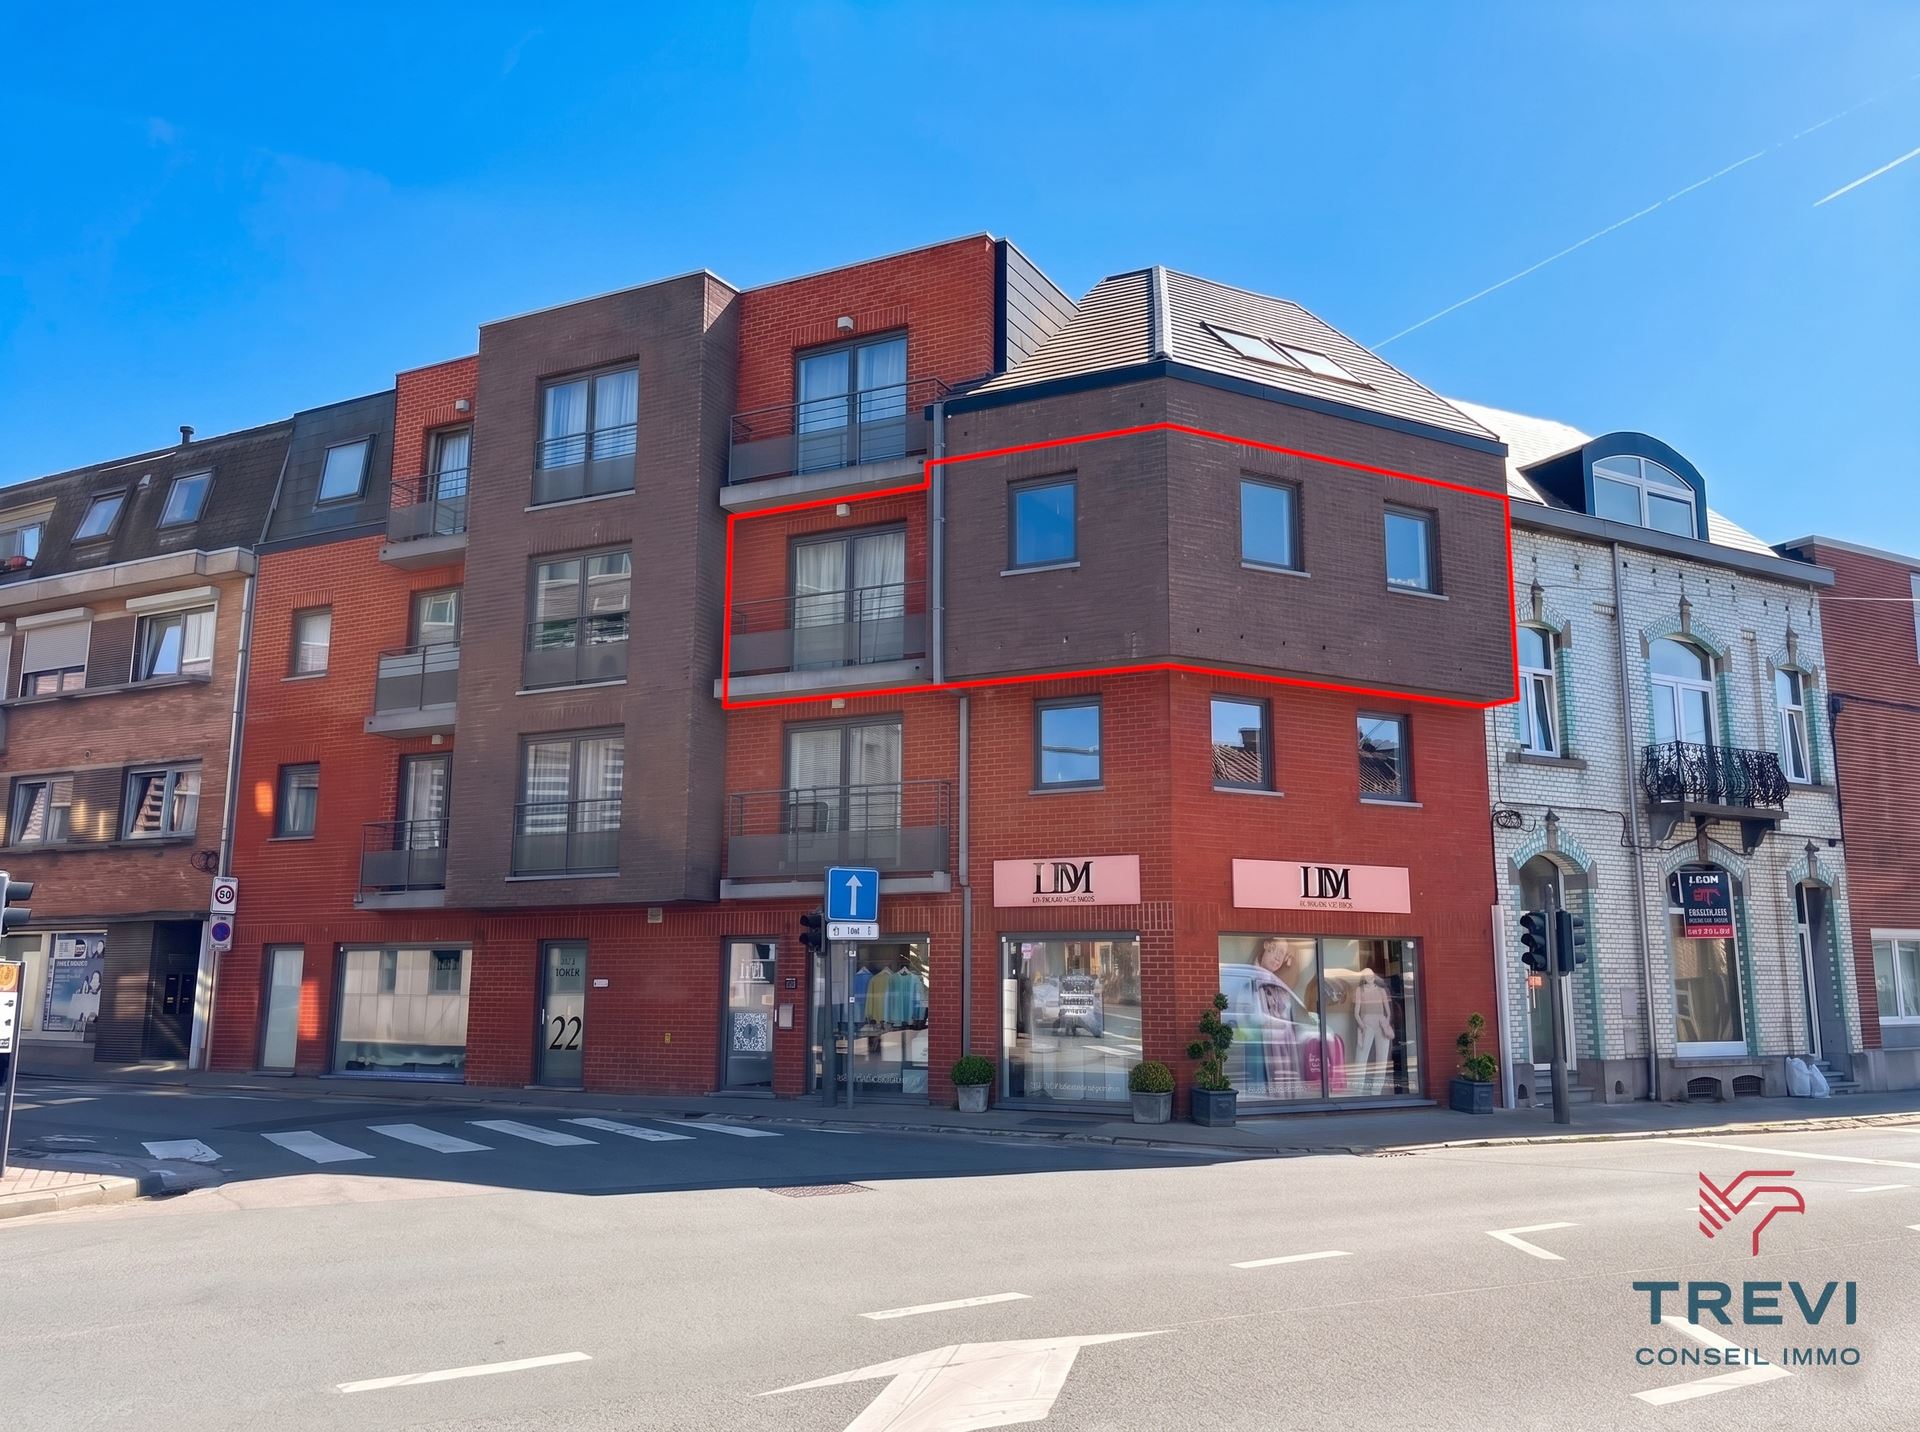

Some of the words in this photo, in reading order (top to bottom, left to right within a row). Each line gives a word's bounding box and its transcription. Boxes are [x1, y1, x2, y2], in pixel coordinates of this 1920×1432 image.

[1033, 861, 1093, 894] LDM
[1300, 866, 1351, 900] LDM
[549, 1015, 582, 1050] 22
